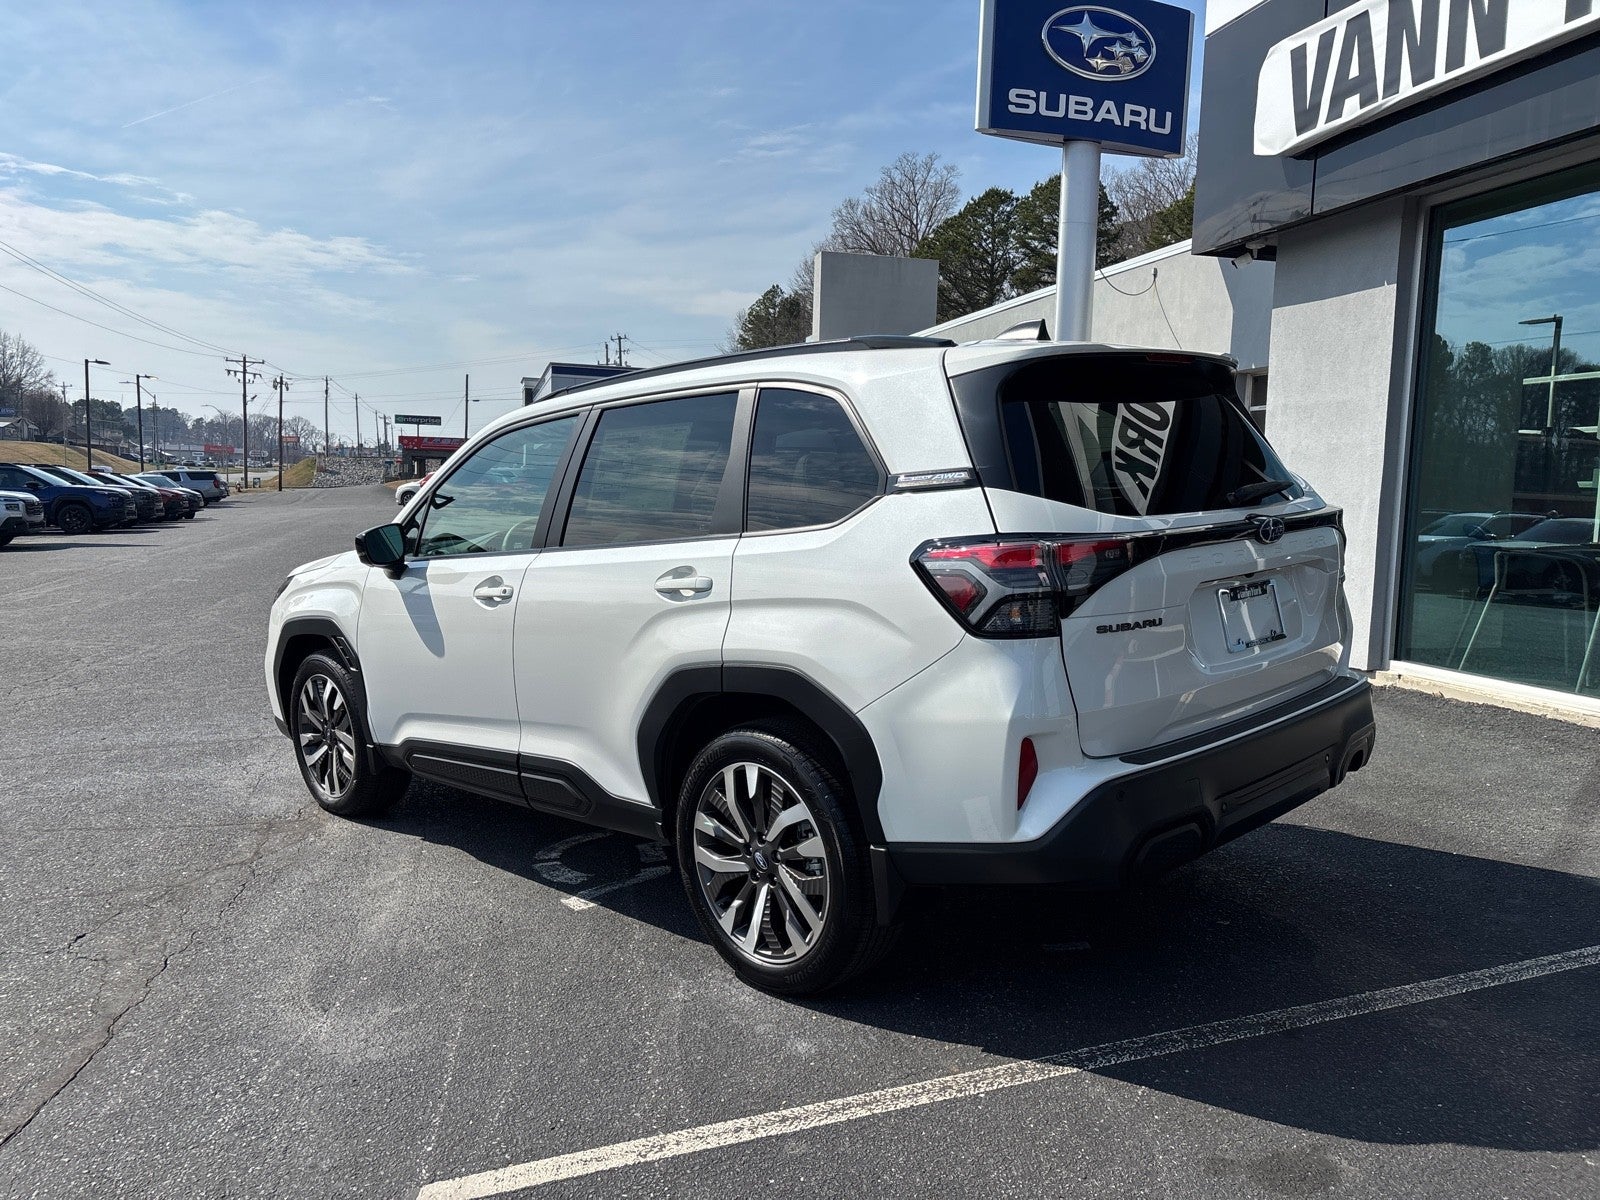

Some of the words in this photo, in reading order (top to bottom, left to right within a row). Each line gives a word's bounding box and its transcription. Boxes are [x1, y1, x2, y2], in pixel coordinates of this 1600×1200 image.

[1290, 0, 1509, 138] VANN
[1007, 88, 1172, 135] SUBARU
[396, 416, 441, 425] enterprise
[1096, 617, 1163, 634] SUBARU
